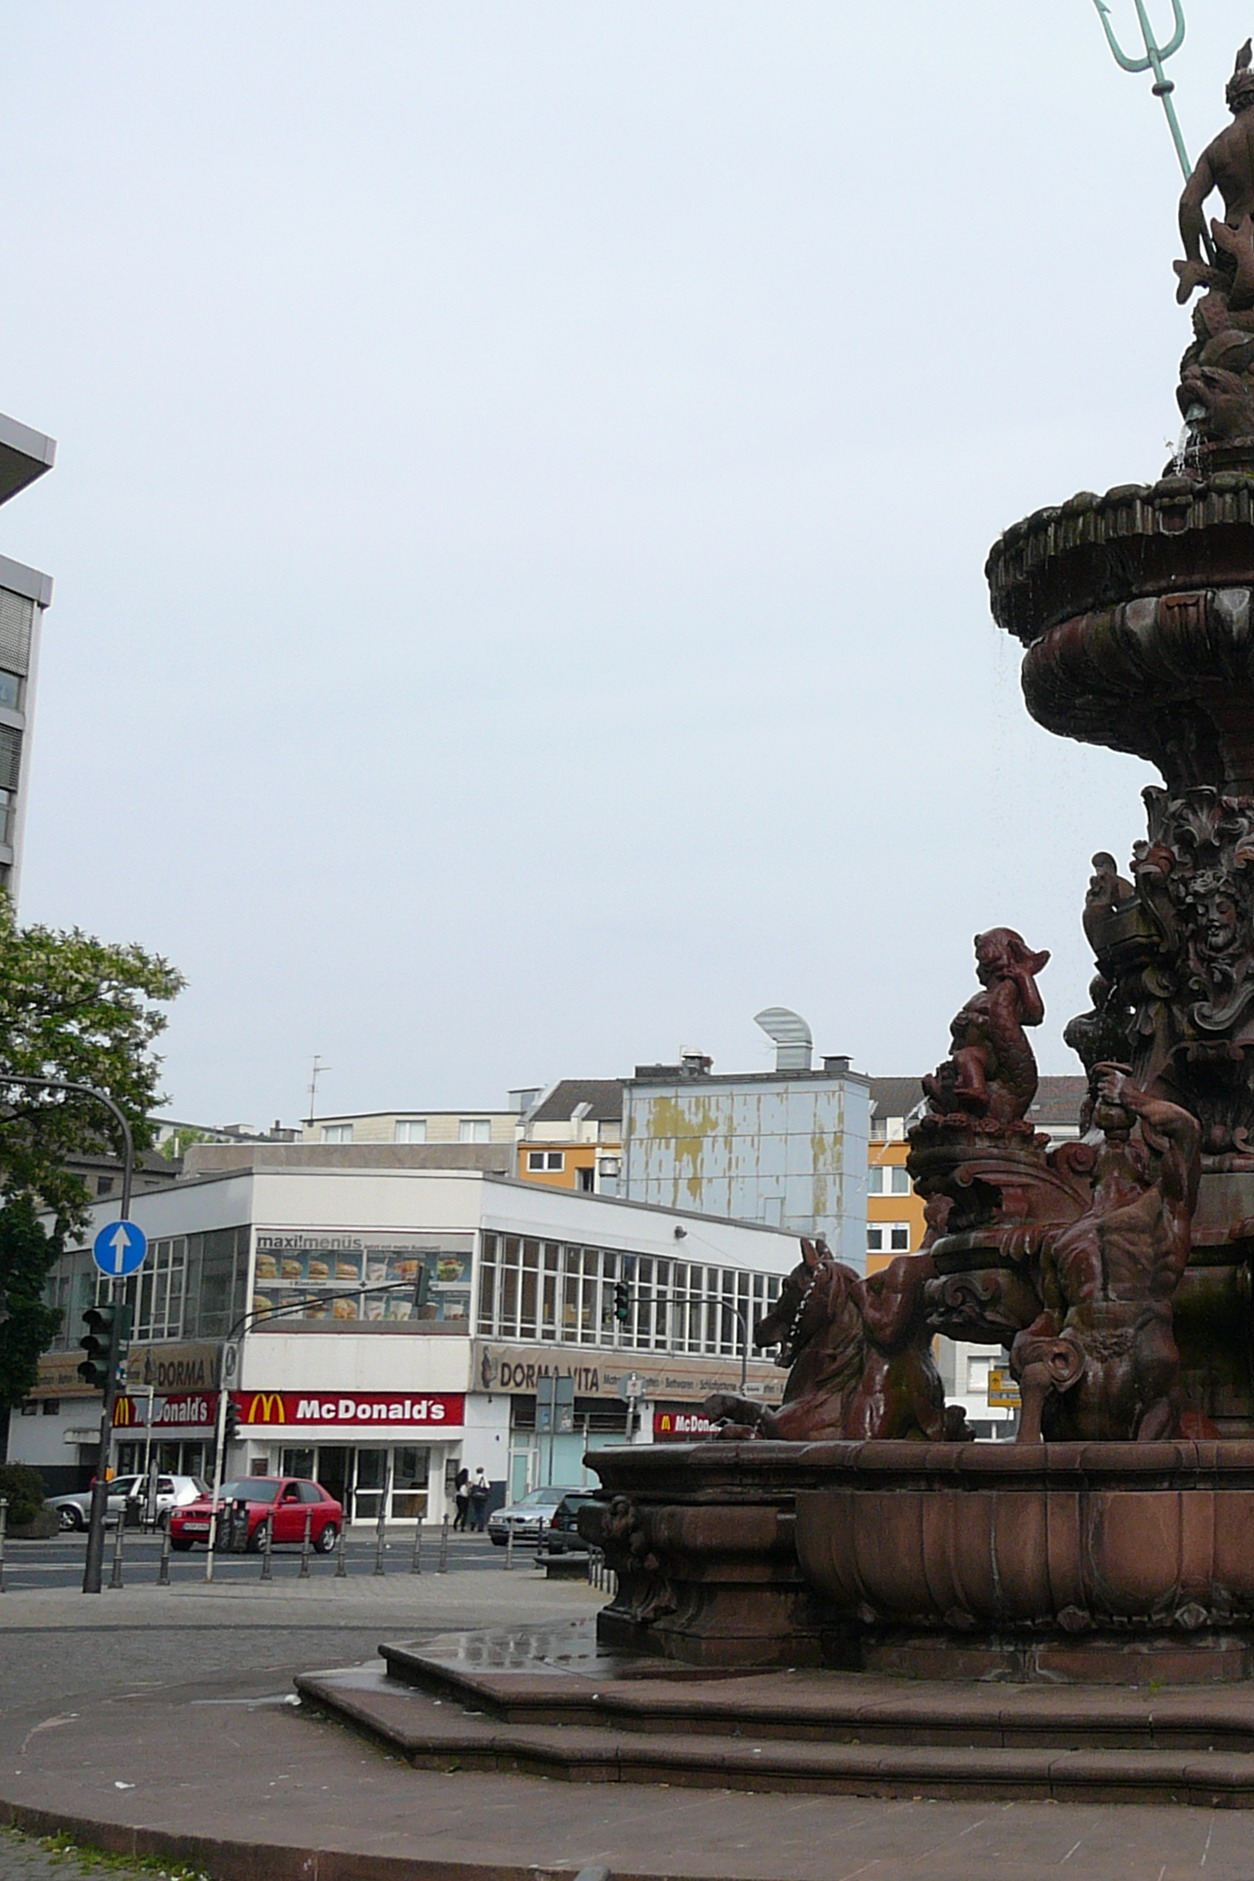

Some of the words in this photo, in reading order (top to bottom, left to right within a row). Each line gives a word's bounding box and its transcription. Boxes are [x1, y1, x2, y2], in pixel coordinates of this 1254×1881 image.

[158, 1360, 205, 1387] DORMA
[567, 1366, 599, 1392] VITA
[134, 1397, 207, 1423] onald's
[296, 1400, 445, 1420] McDonald's
[675, 1415, 722, 1432] McDon
